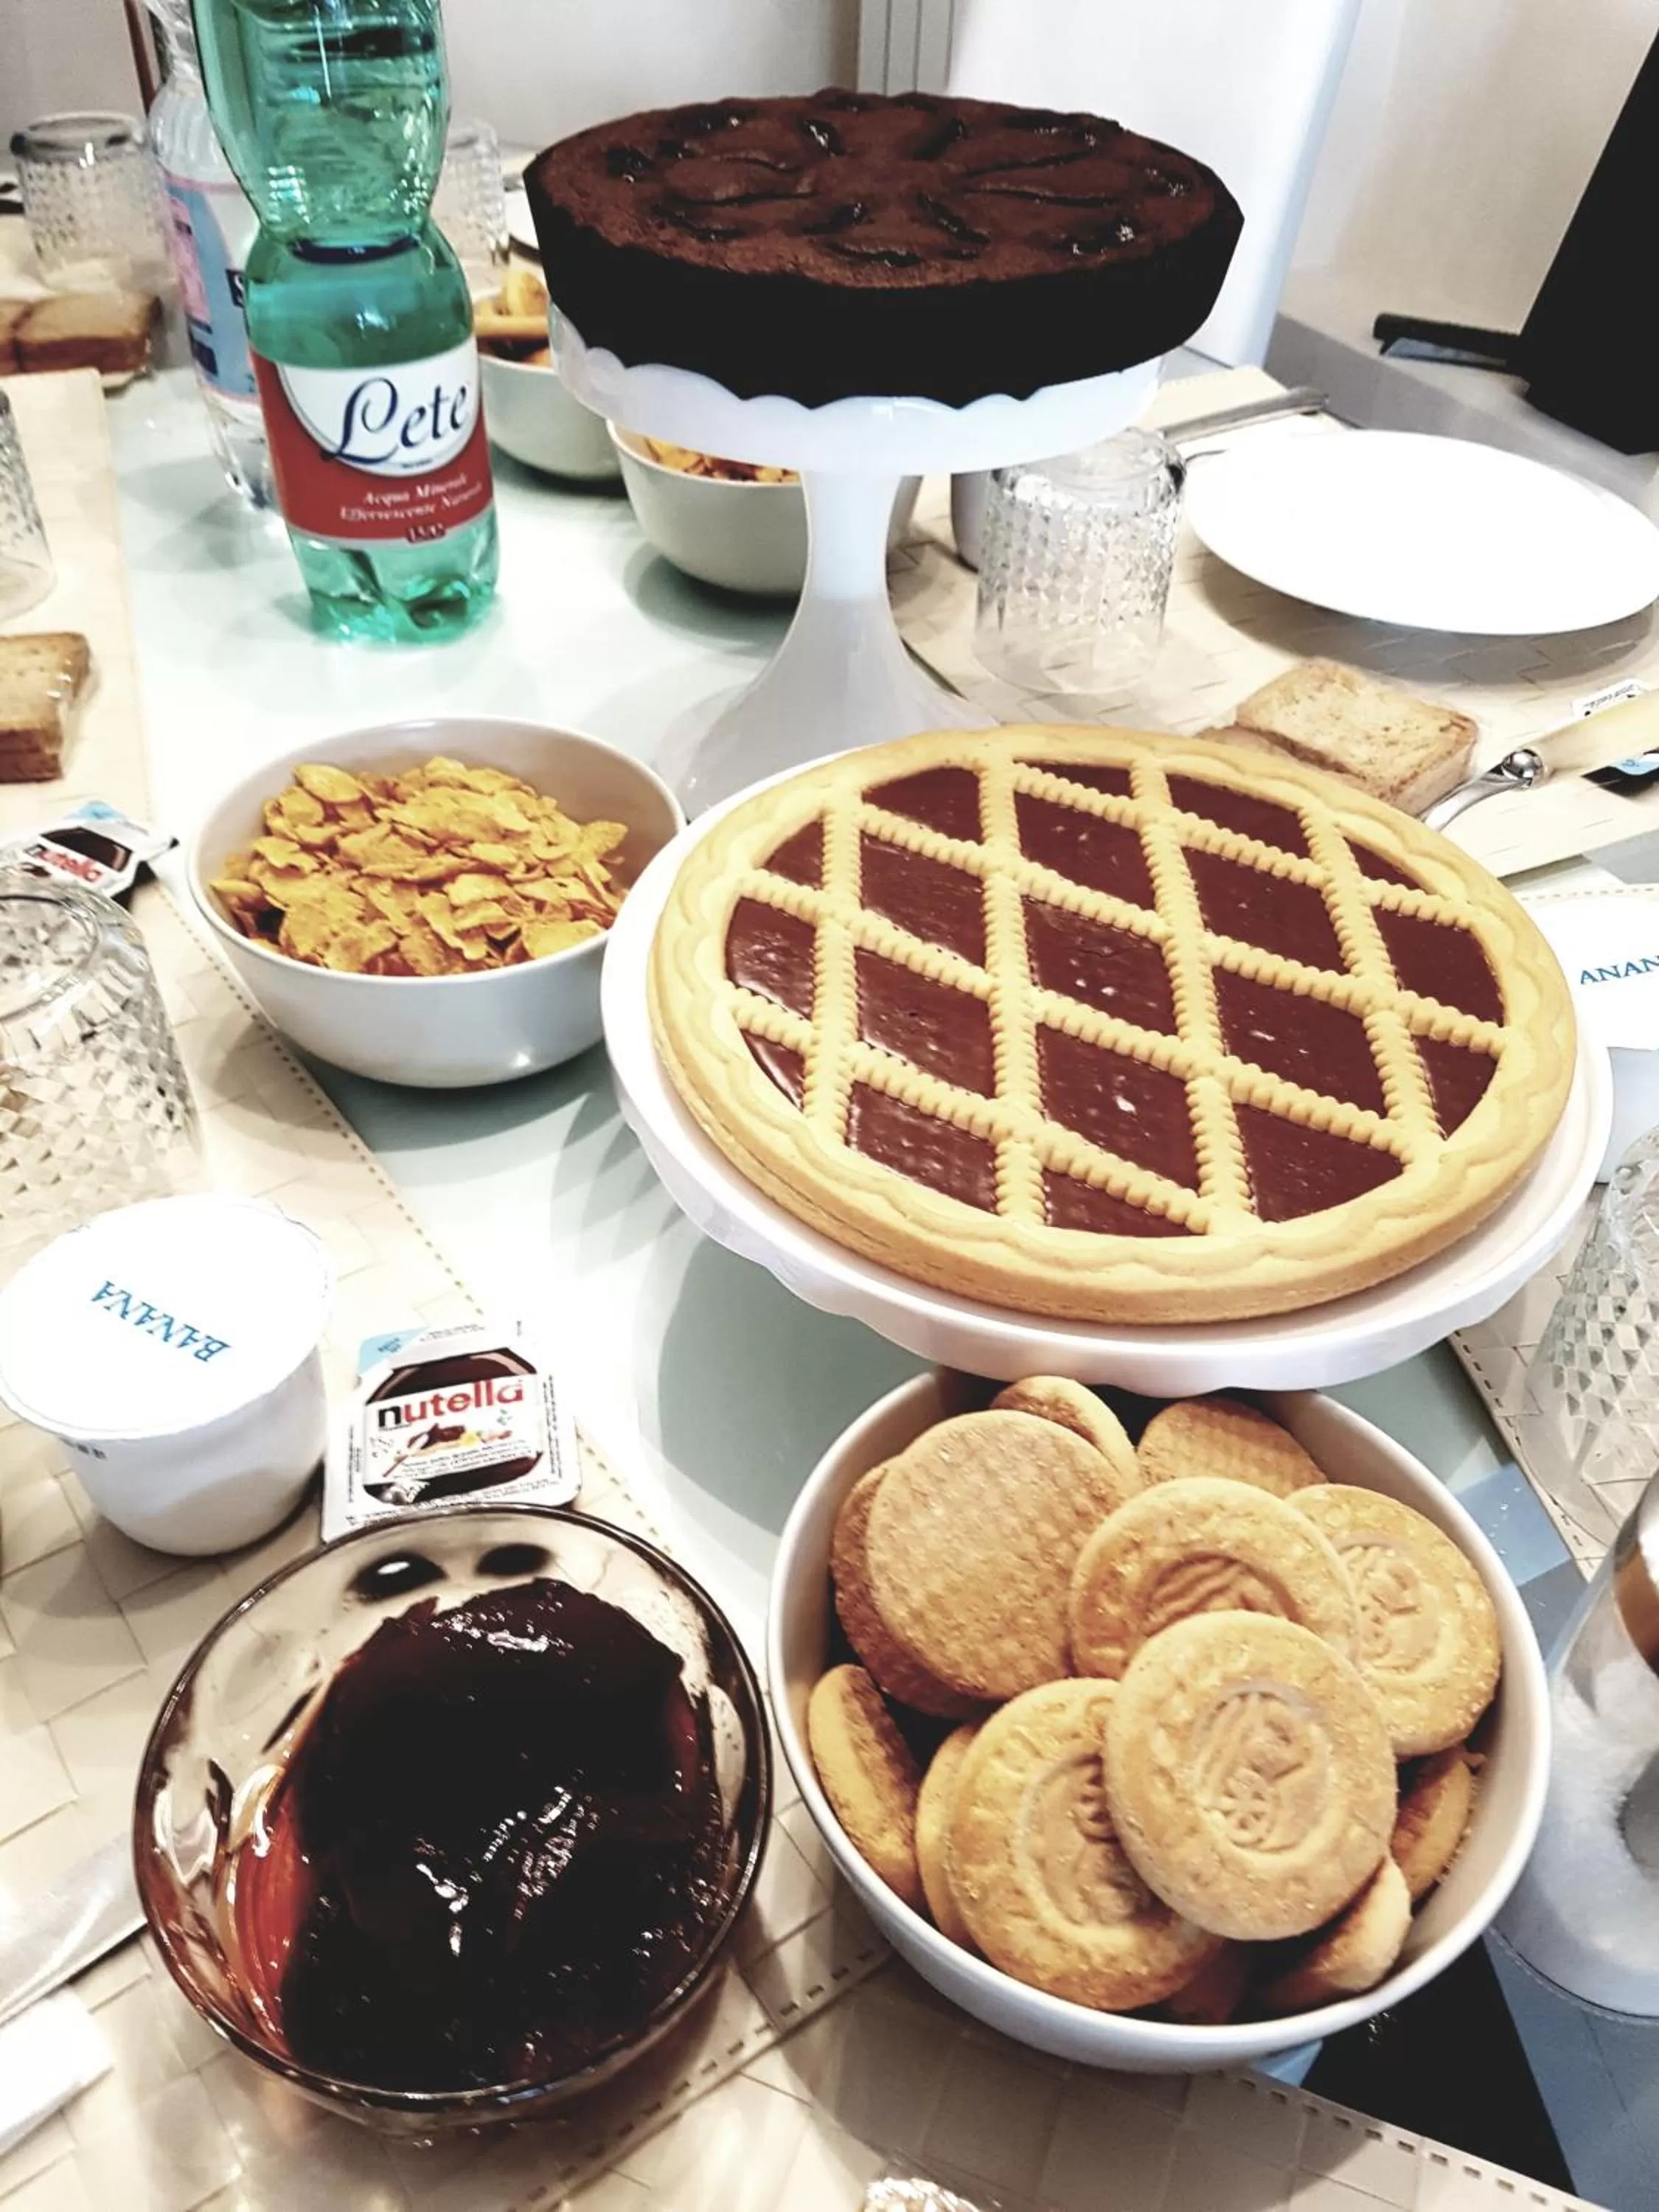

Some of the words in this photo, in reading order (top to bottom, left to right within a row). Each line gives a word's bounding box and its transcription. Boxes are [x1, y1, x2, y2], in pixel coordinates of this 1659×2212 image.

[329, 377, 470, 465] Lete
[364, 490, 410, 508] Acqua
[1579, 955, 1659, 985] ANAN
[90, 1280, 232, 1363] BANANA
[378, 1380, 524, 1428] nutella
